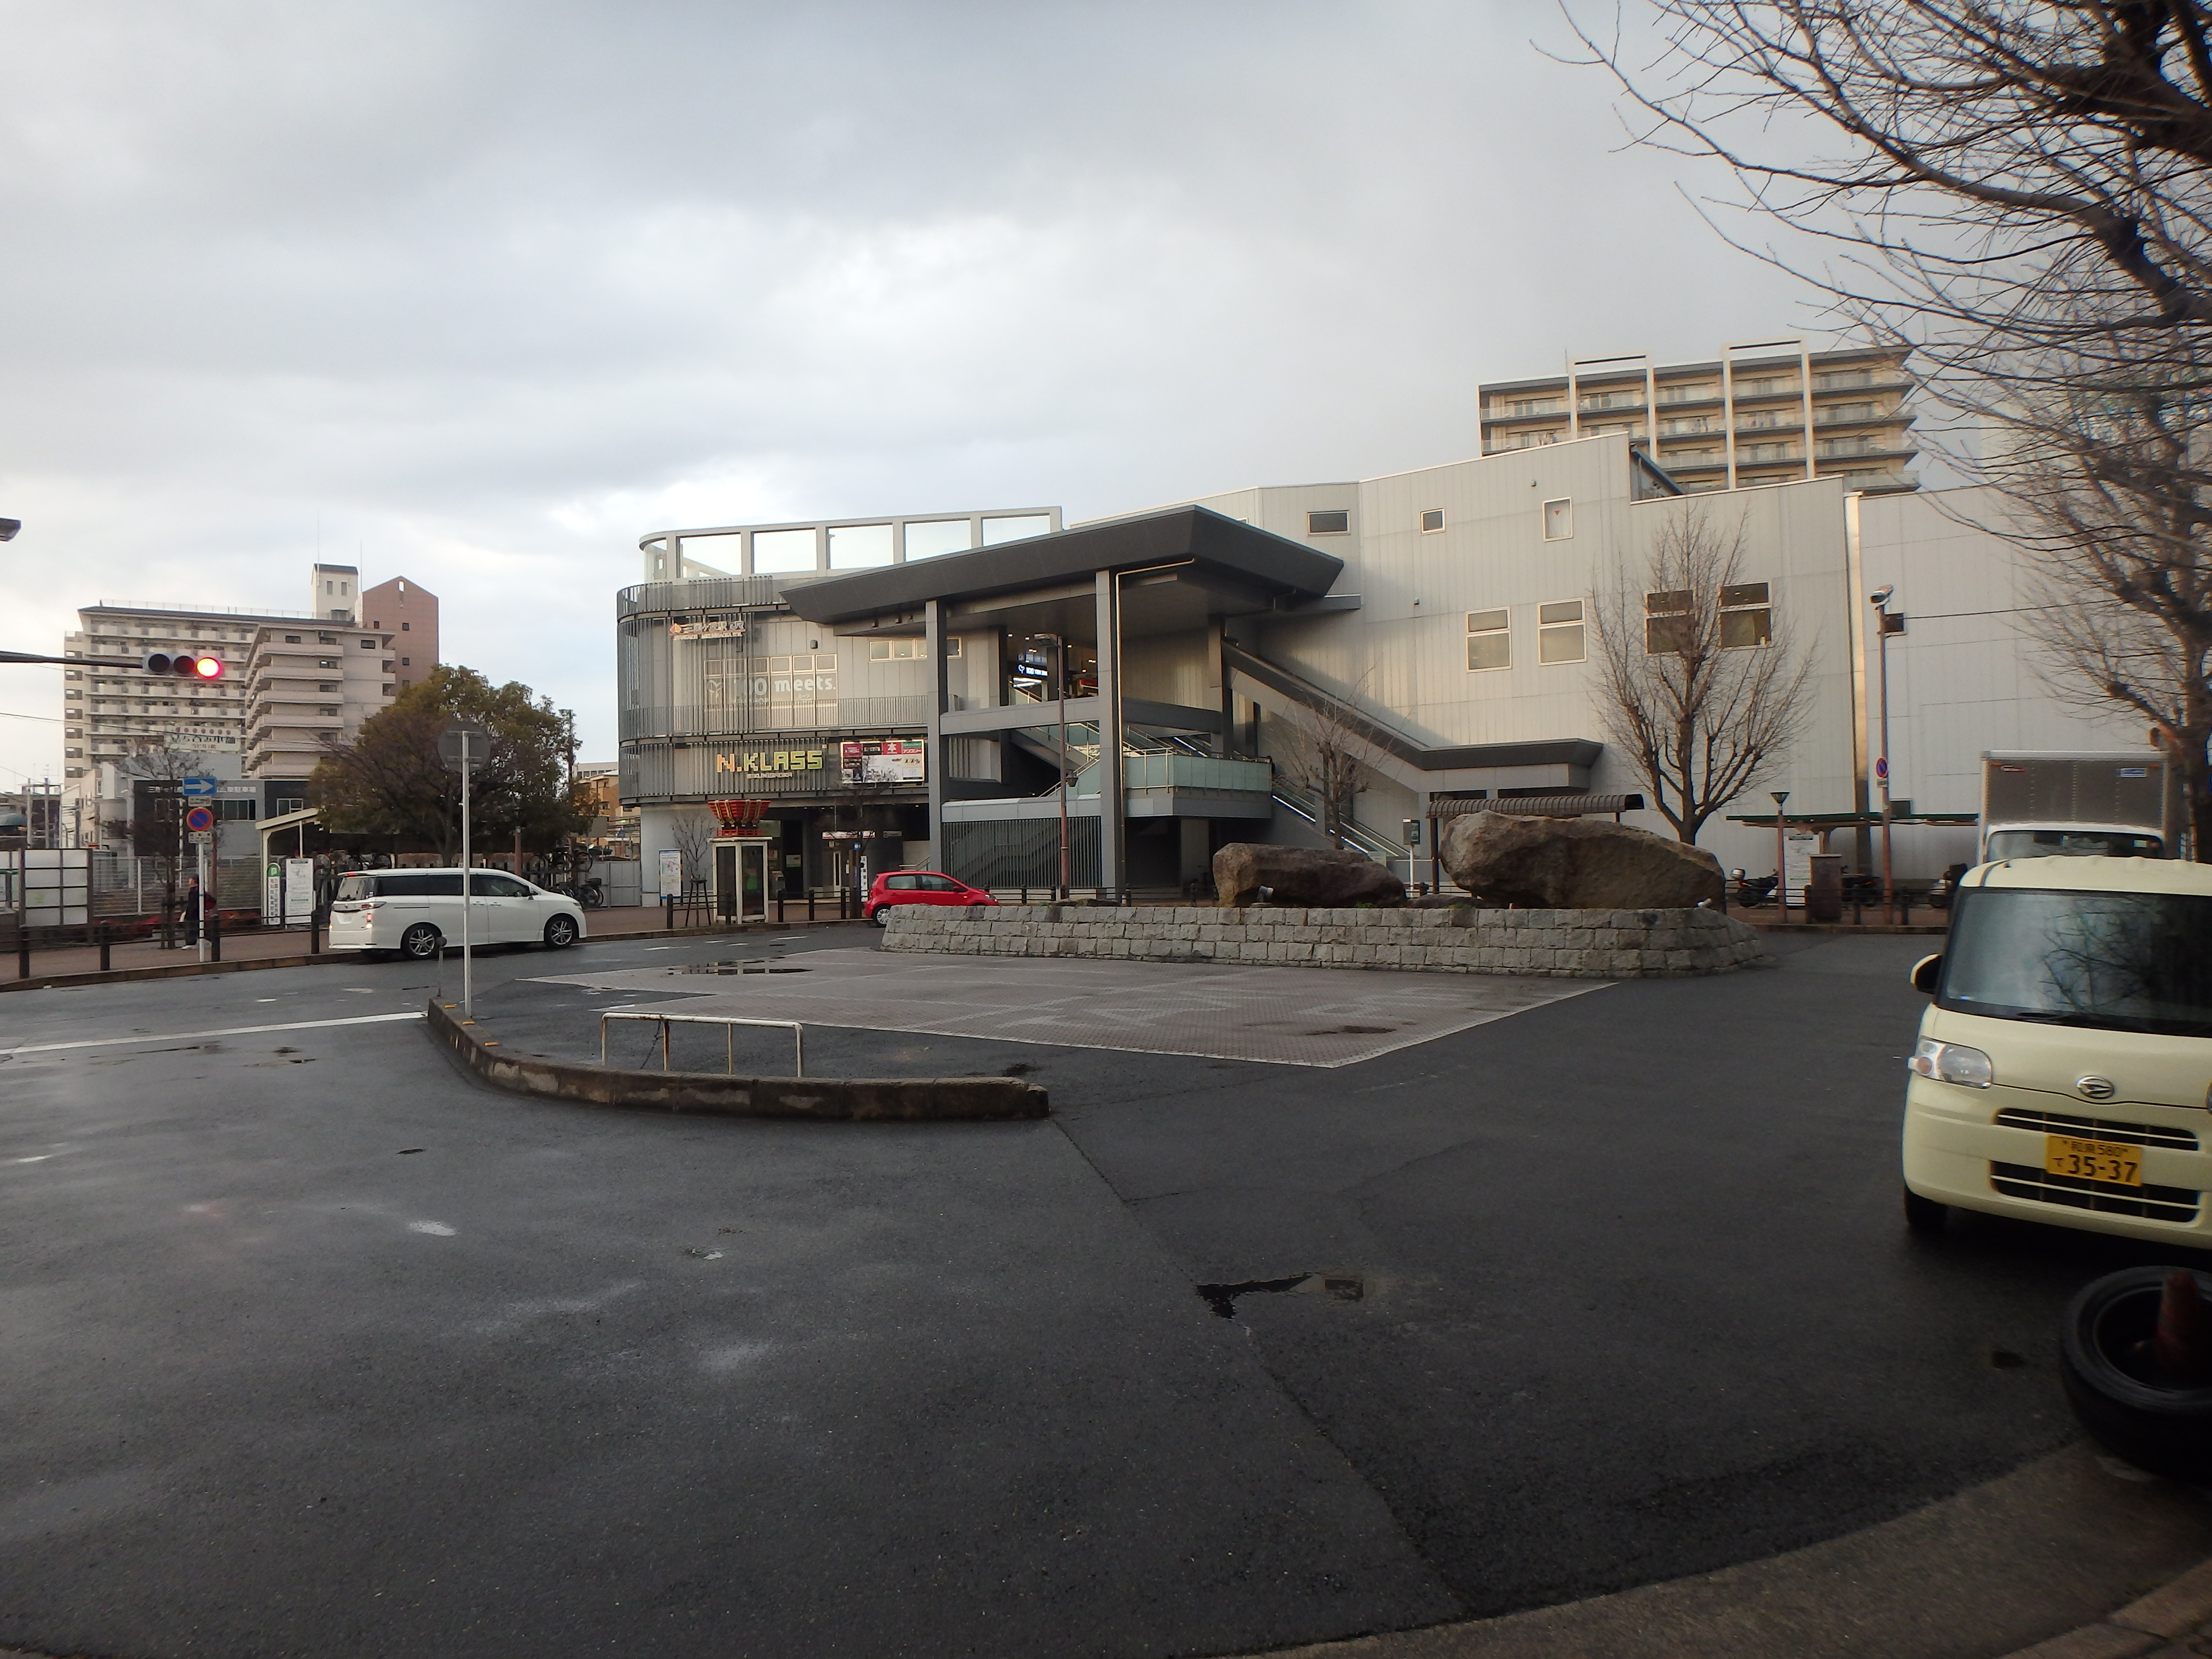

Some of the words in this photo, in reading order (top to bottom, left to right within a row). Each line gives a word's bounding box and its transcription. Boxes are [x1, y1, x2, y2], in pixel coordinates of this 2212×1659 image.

[730, 621, 744, 630] JR
[774, 676, 836, 692] meets.
[717, 750, 823, 773] N.KLASS
[271, 867, 277, 876] P
[2067, 1154, 2138, 1182] 35-37
